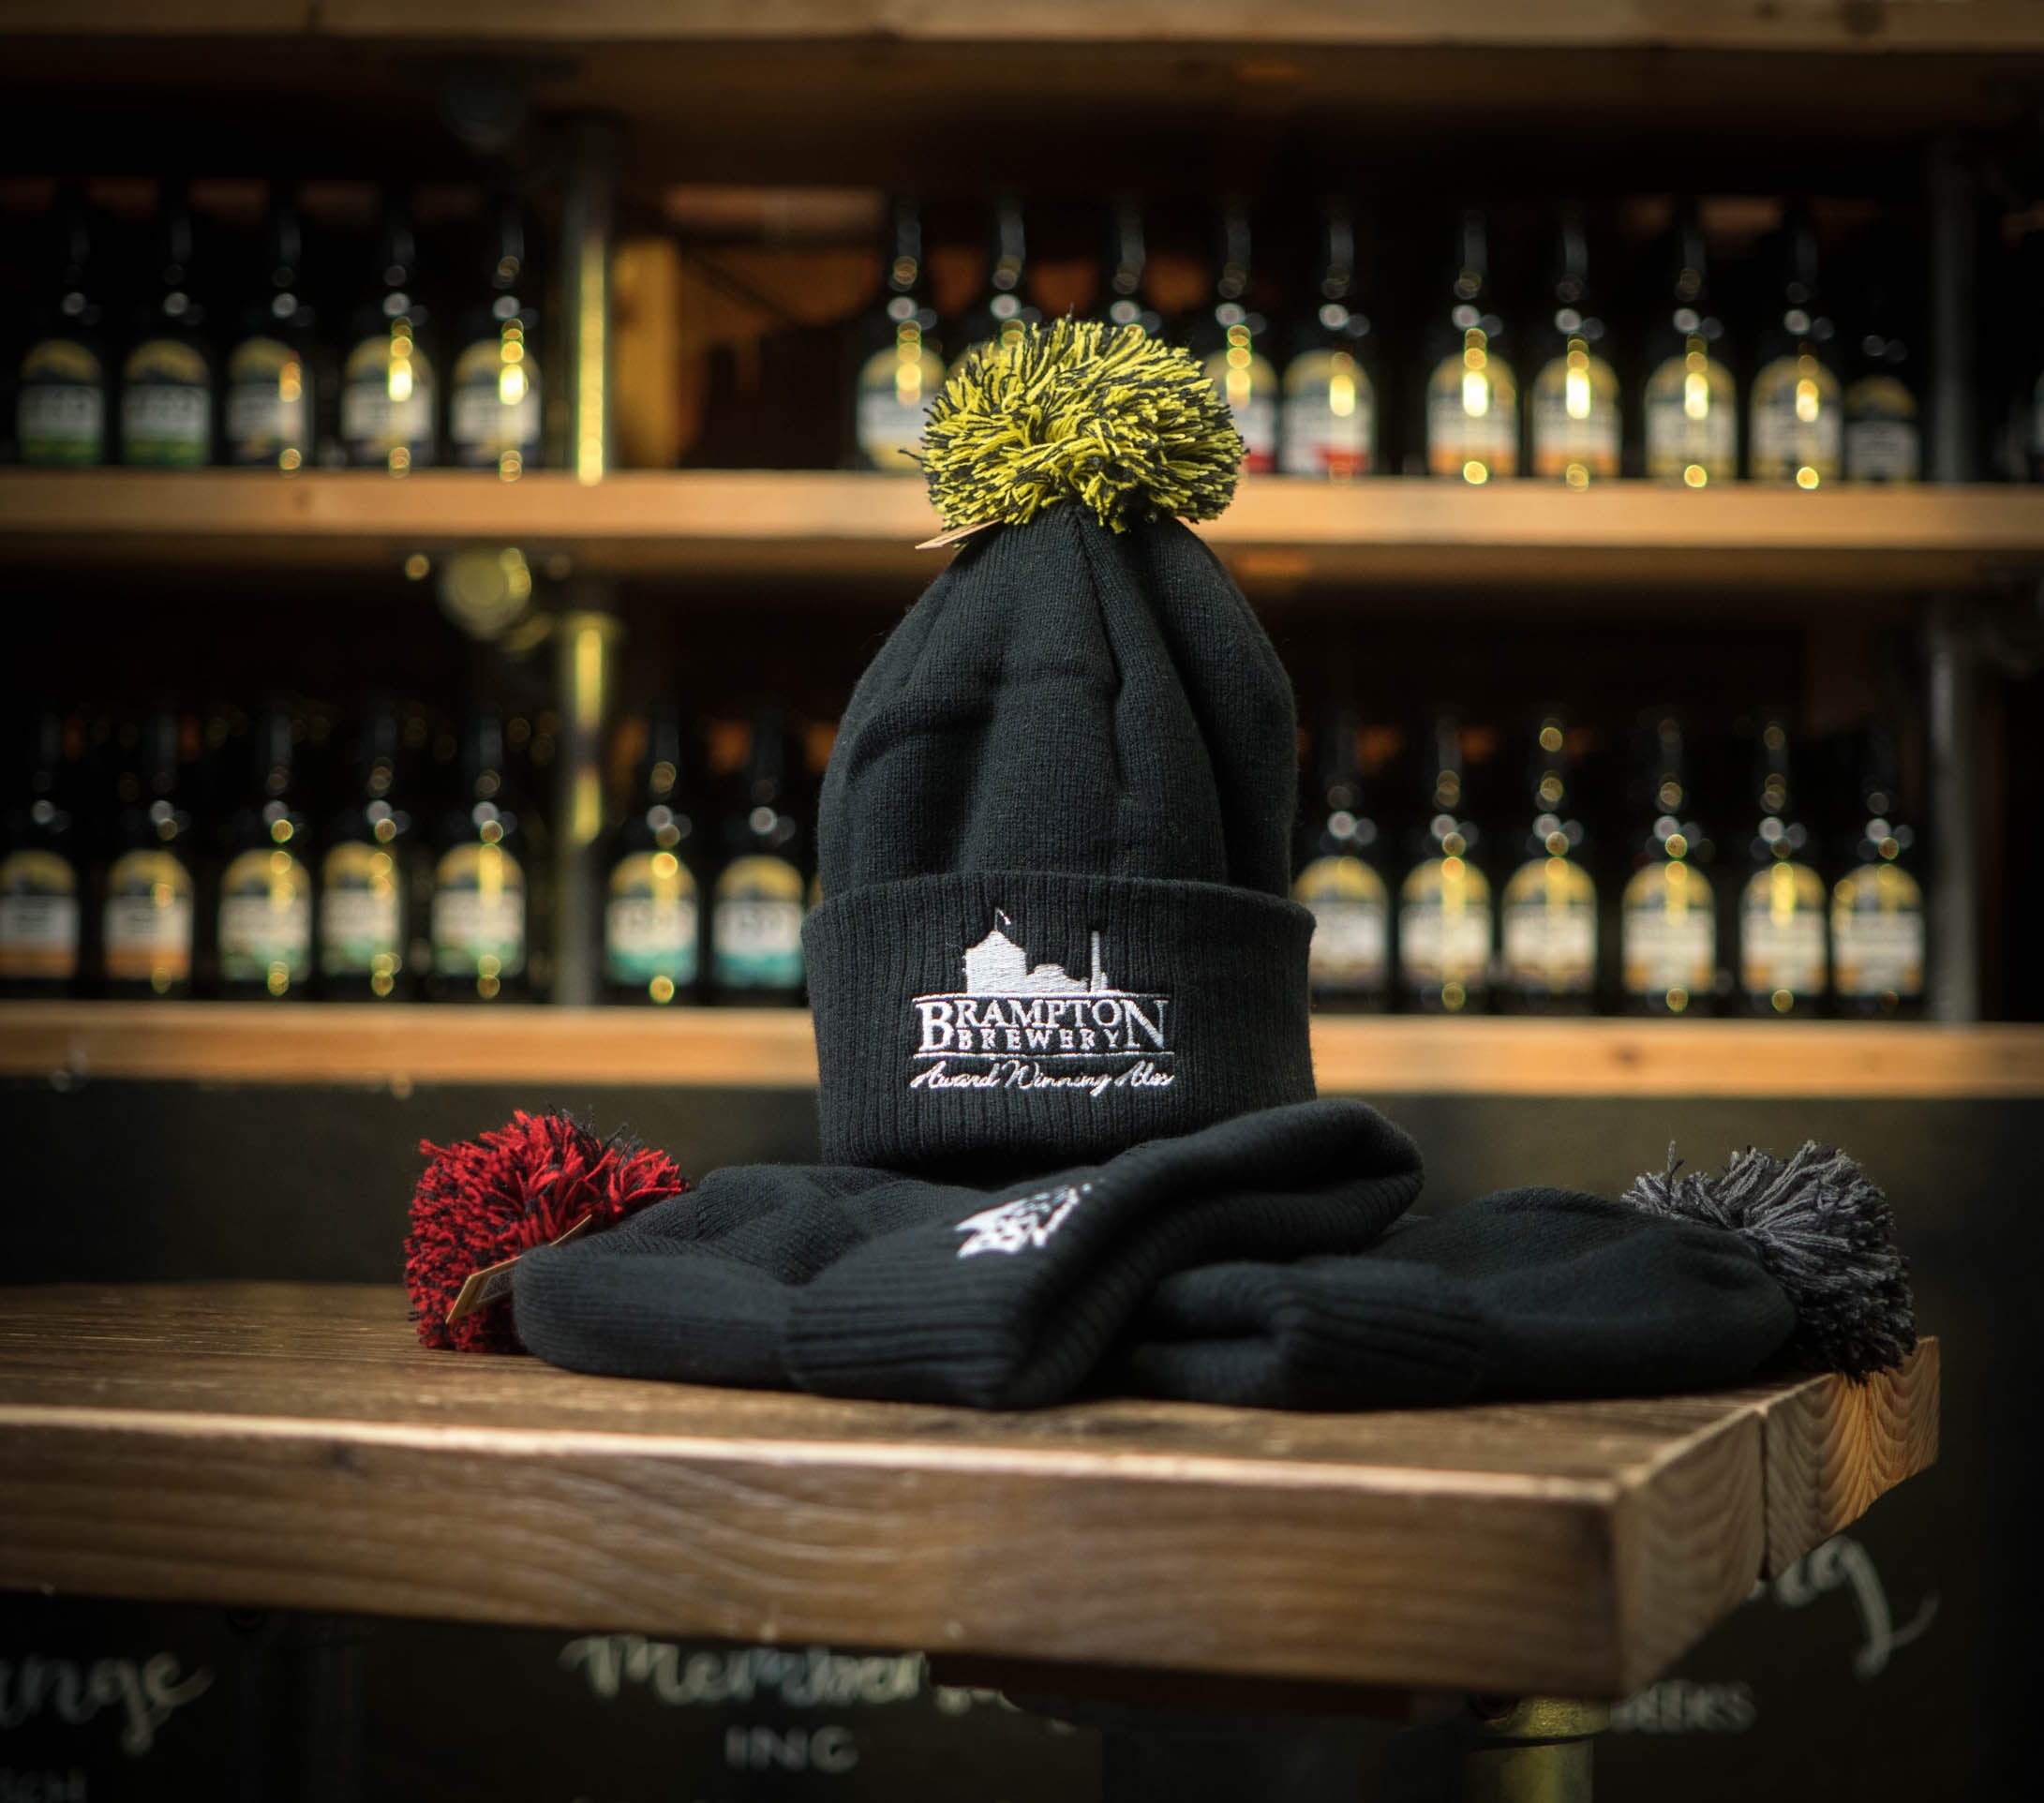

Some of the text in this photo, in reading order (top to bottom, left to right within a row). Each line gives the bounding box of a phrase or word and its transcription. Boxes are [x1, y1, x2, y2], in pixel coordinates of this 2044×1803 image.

[915, 998, 1169, 1051] BRAMPTON
[957, 1028, 1121, 1051] BREWERY
[910, 1059, 1175, 1097] Award Winning Ales
